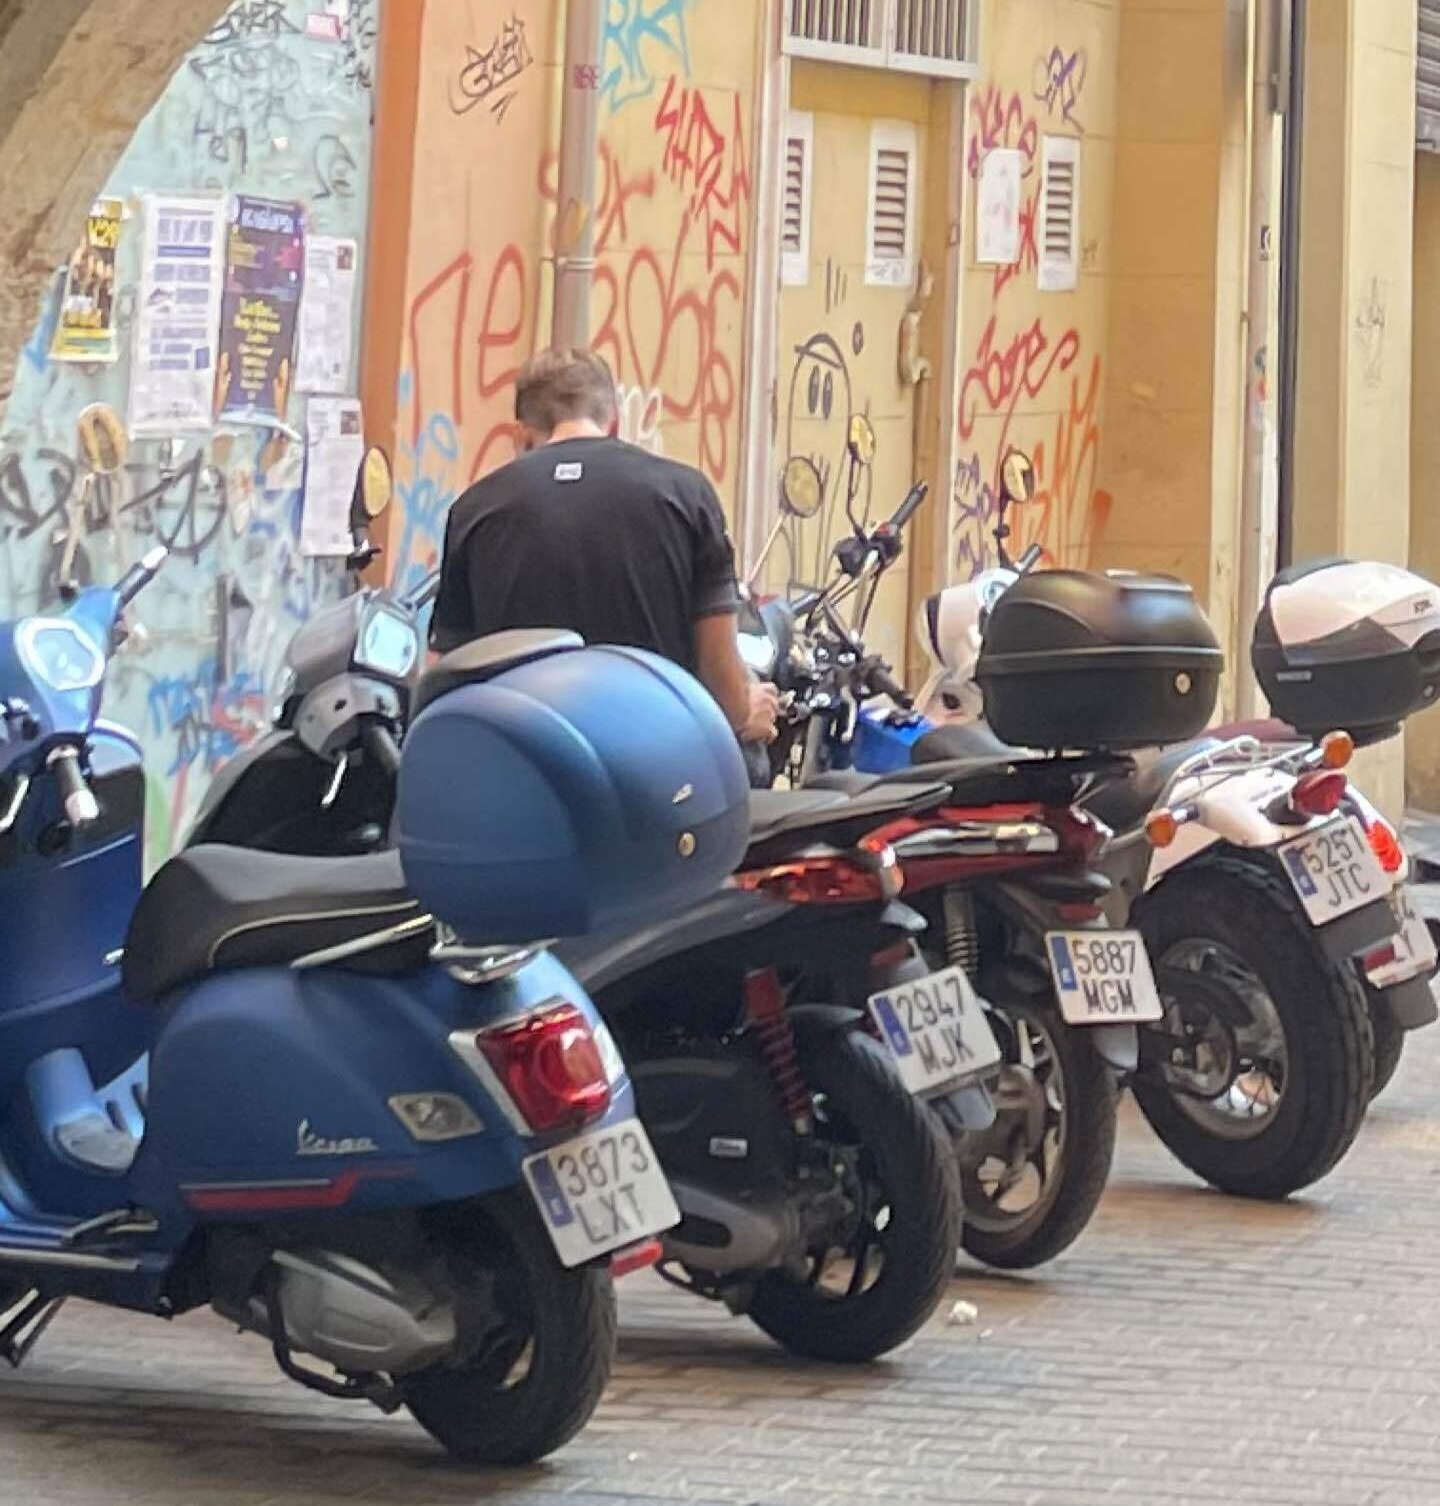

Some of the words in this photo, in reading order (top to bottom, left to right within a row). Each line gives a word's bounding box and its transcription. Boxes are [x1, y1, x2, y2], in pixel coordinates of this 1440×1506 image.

[1303, 824, 1366, 874] 5251
[1327, 862, 1371, 908] JTC
[1072, 939, 1137, 976] 5887
[896, 974, 965, 1034] 2947
[1082, 978, 1137, 1015] MGM
[914, 1025, 976, 1076] MJK
[296, 1117, 380, 1157] Vespa
[557, 1130, 649, 1198] 3873
[575, 1182, 646, 1246] LXT
